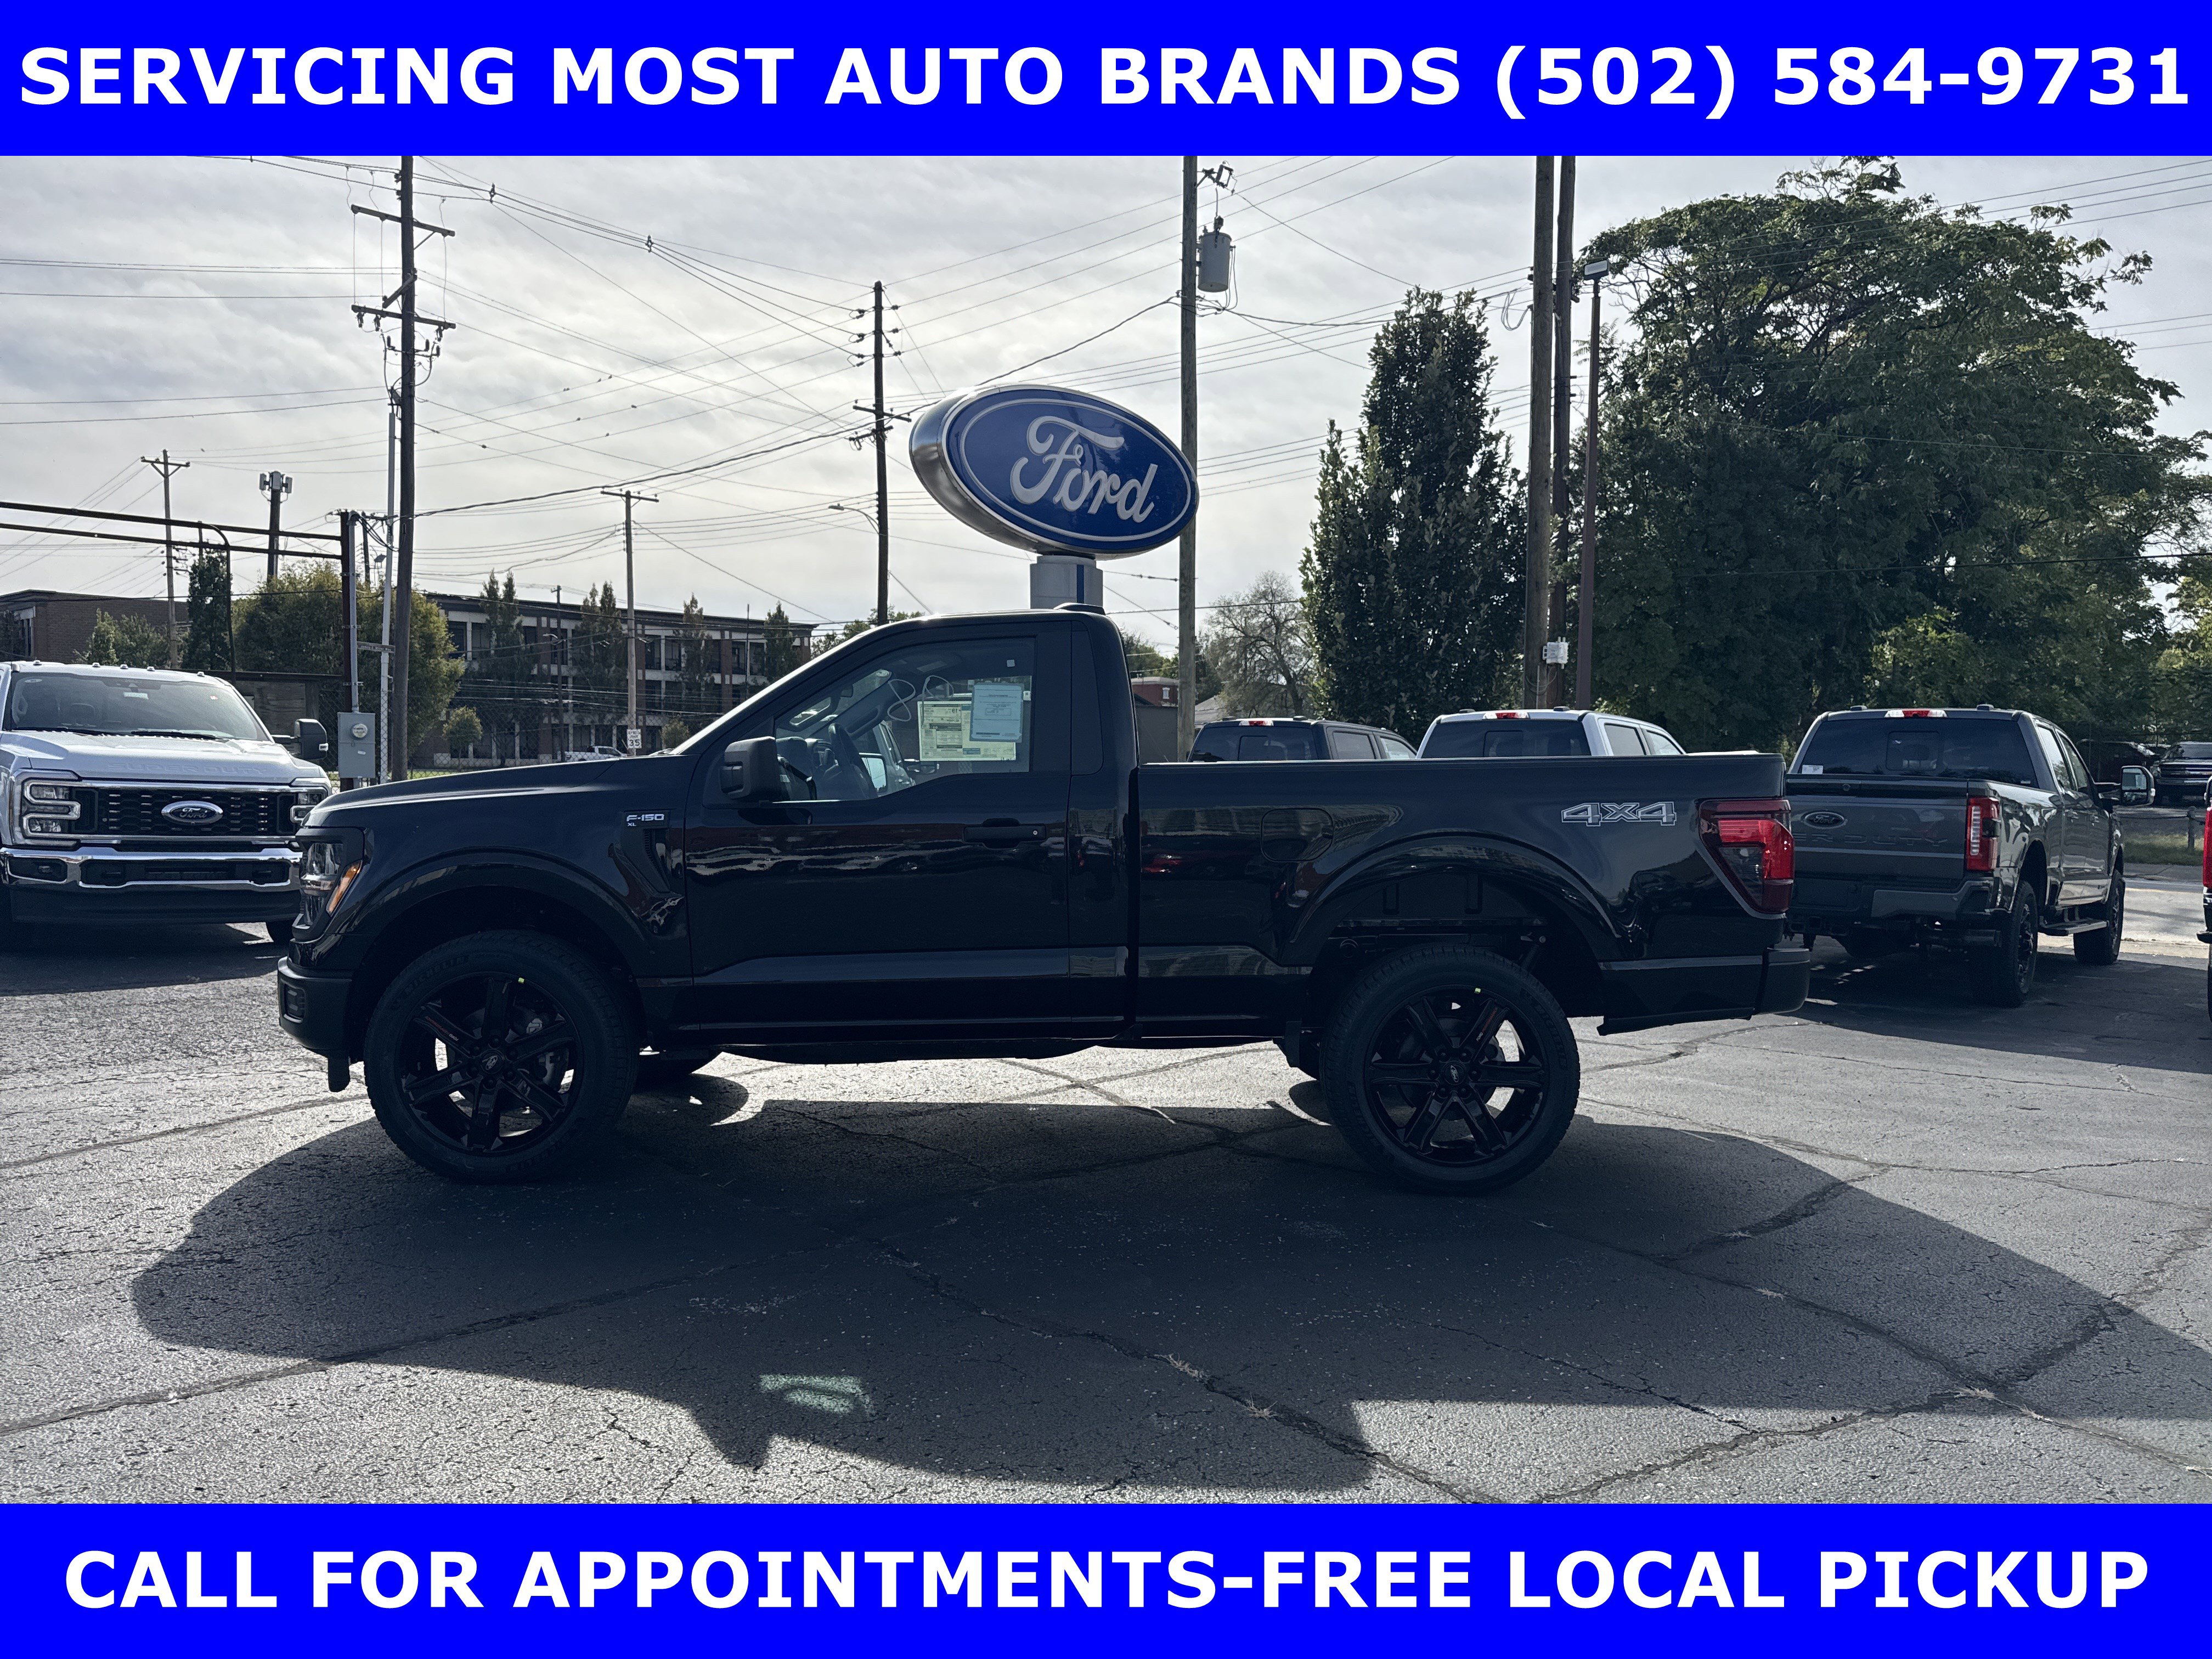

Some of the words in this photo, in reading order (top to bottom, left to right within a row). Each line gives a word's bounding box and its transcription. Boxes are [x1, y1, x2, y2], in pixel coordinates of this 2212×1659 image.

[1010, 416, 1154, 523] Ford
[108, 763, 199, 773] SUPER
[204, 765, 267, 775] DUTY
[179, 807, 208, 818] Ford
[626, 814, 665, 822] F-150
[1844, 834, 1949, 847] DUTY
